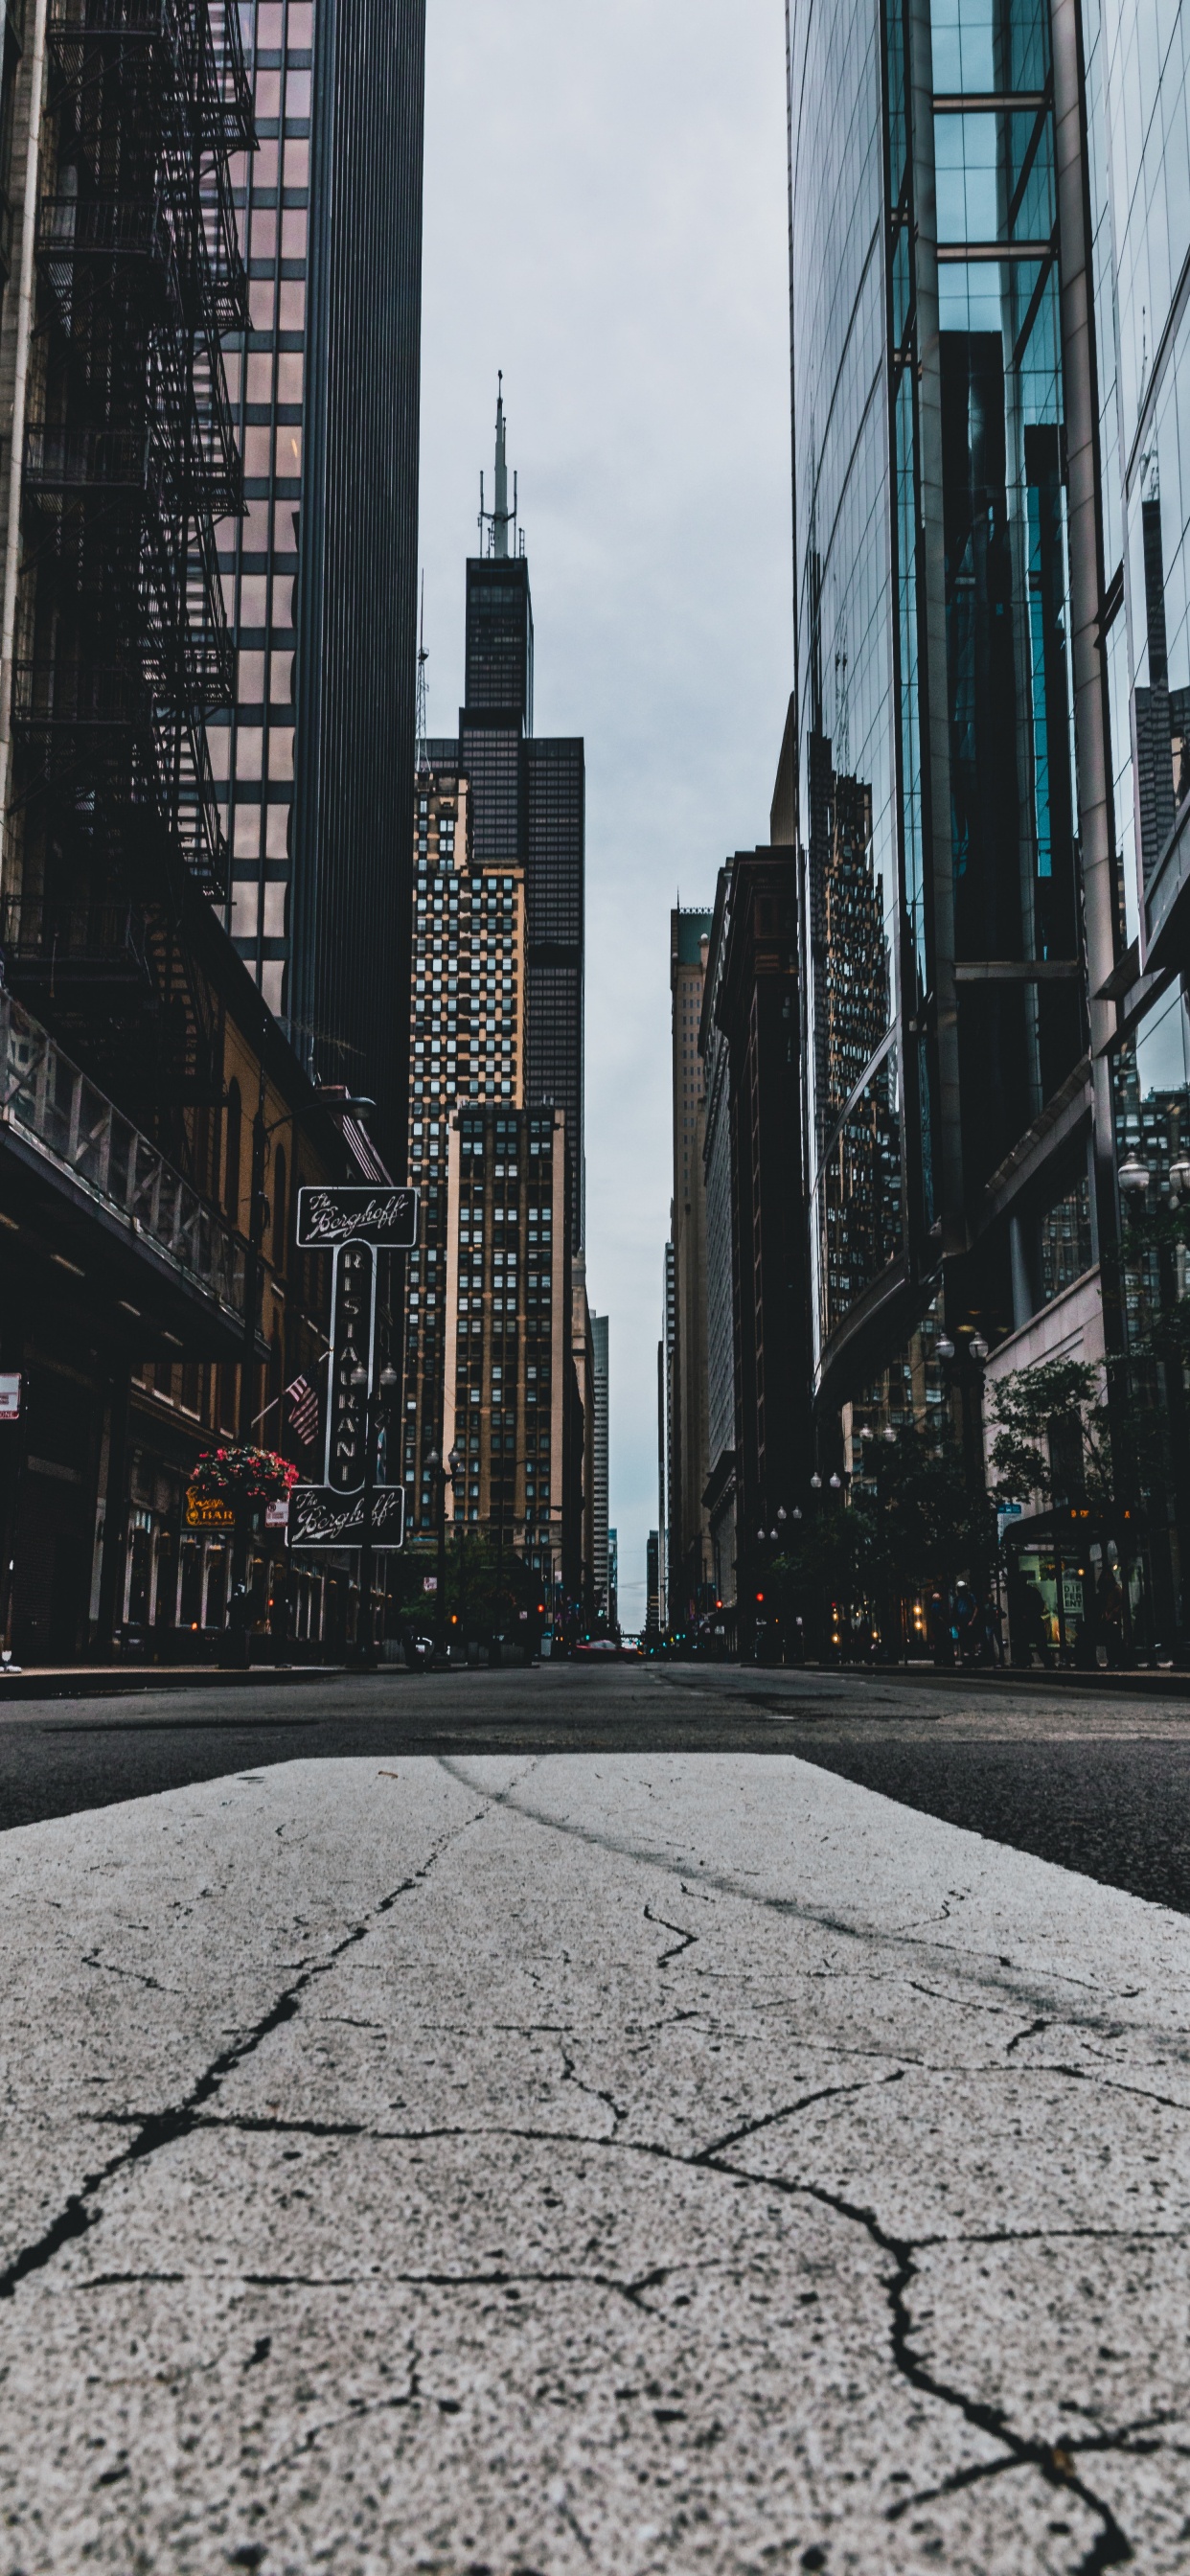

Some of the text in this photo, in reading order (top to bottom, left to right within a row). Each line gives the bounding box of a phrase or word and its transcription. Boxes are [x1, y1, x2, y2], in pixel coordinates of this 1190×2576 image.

[309, 1192, 332, 1210] The
[295, 1490, 318, 1509] The
[202, 1510, 233, 1520] BAR
